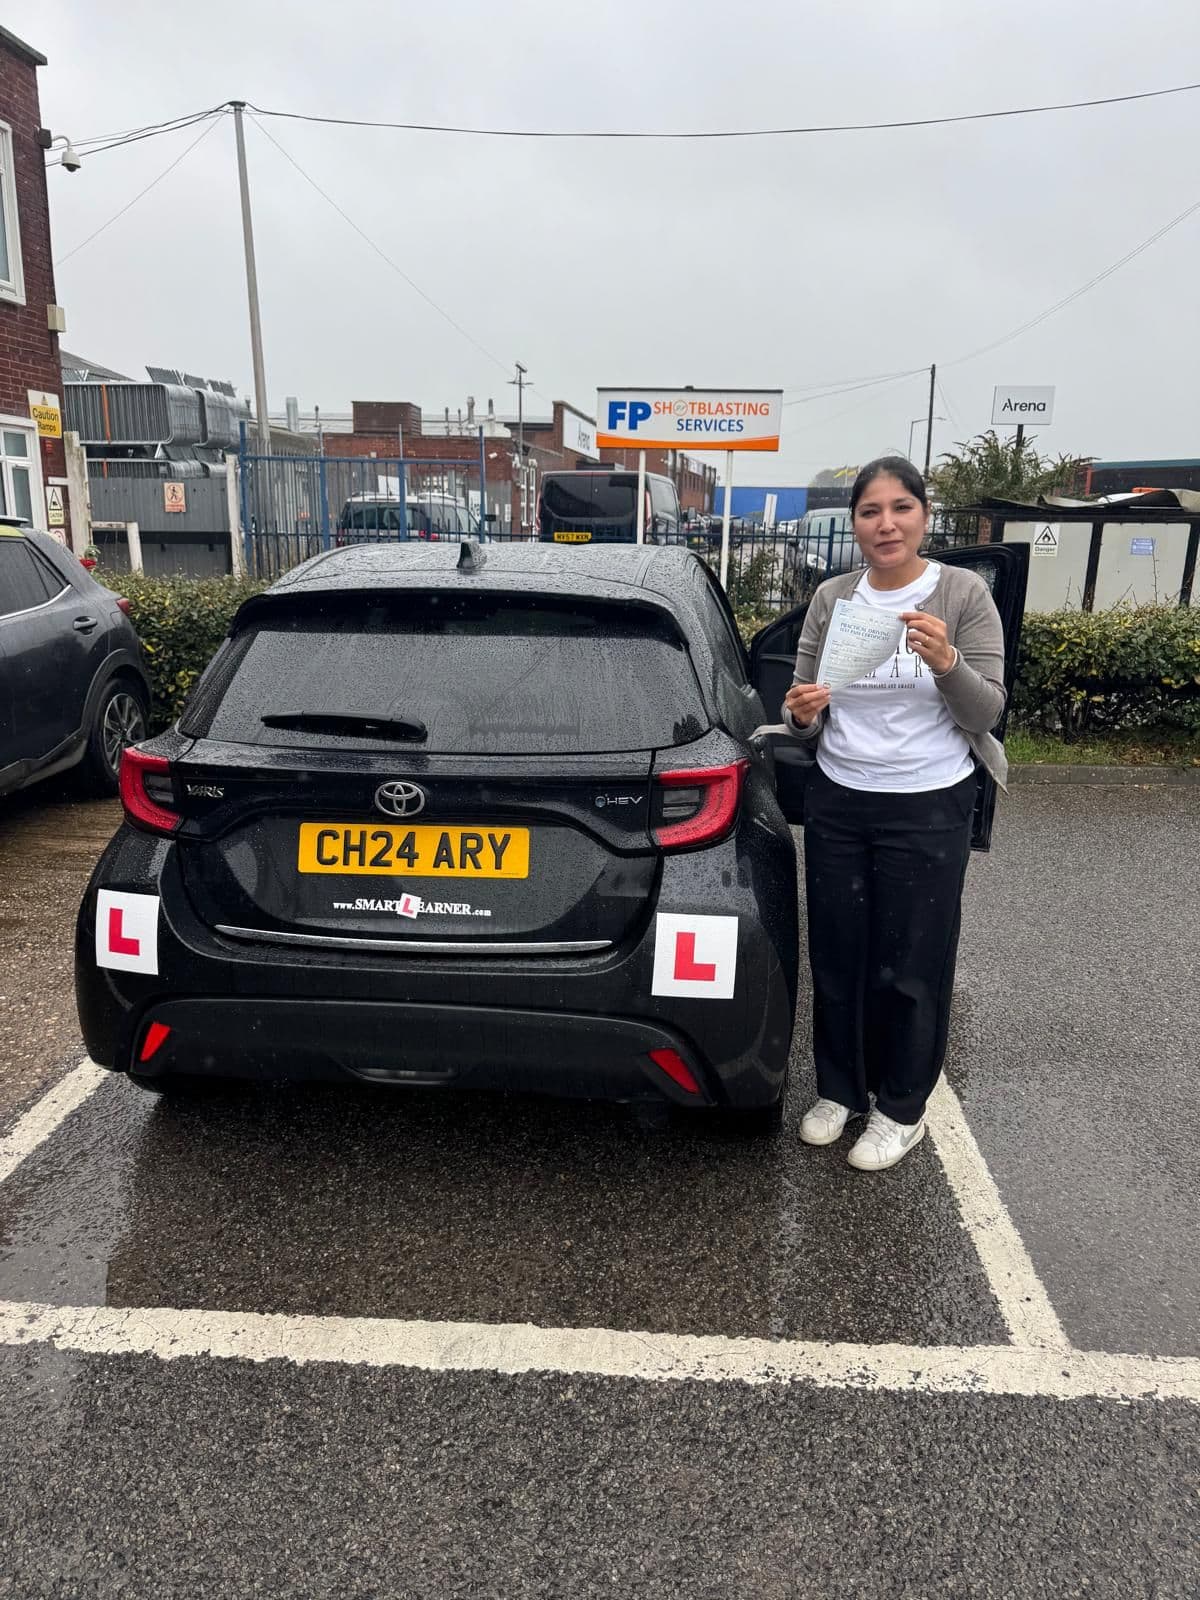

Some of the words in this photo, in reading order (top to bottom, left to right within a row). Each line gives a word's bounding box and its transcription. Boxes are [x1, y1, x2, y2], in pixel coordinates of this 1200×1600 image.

[1002, 398, 1047, 412] Arena
[32, 408, 59, 421] Caution
[608, 400, 652, 430] FP
[654, 400, 770, 417] SHOTBLASTING
[38, 421, 57, 432] Ramps
[676, 418, 744, 433] SERVICES
[186, 784, 225, 798] YARIS
[607, 796, 643, 806] HEV
[316, 829, 419, 868] CH24
[433, 832, 512, 871] ARY
[109, 907, 140, 956] L
[674, 931, 717, 981] L
